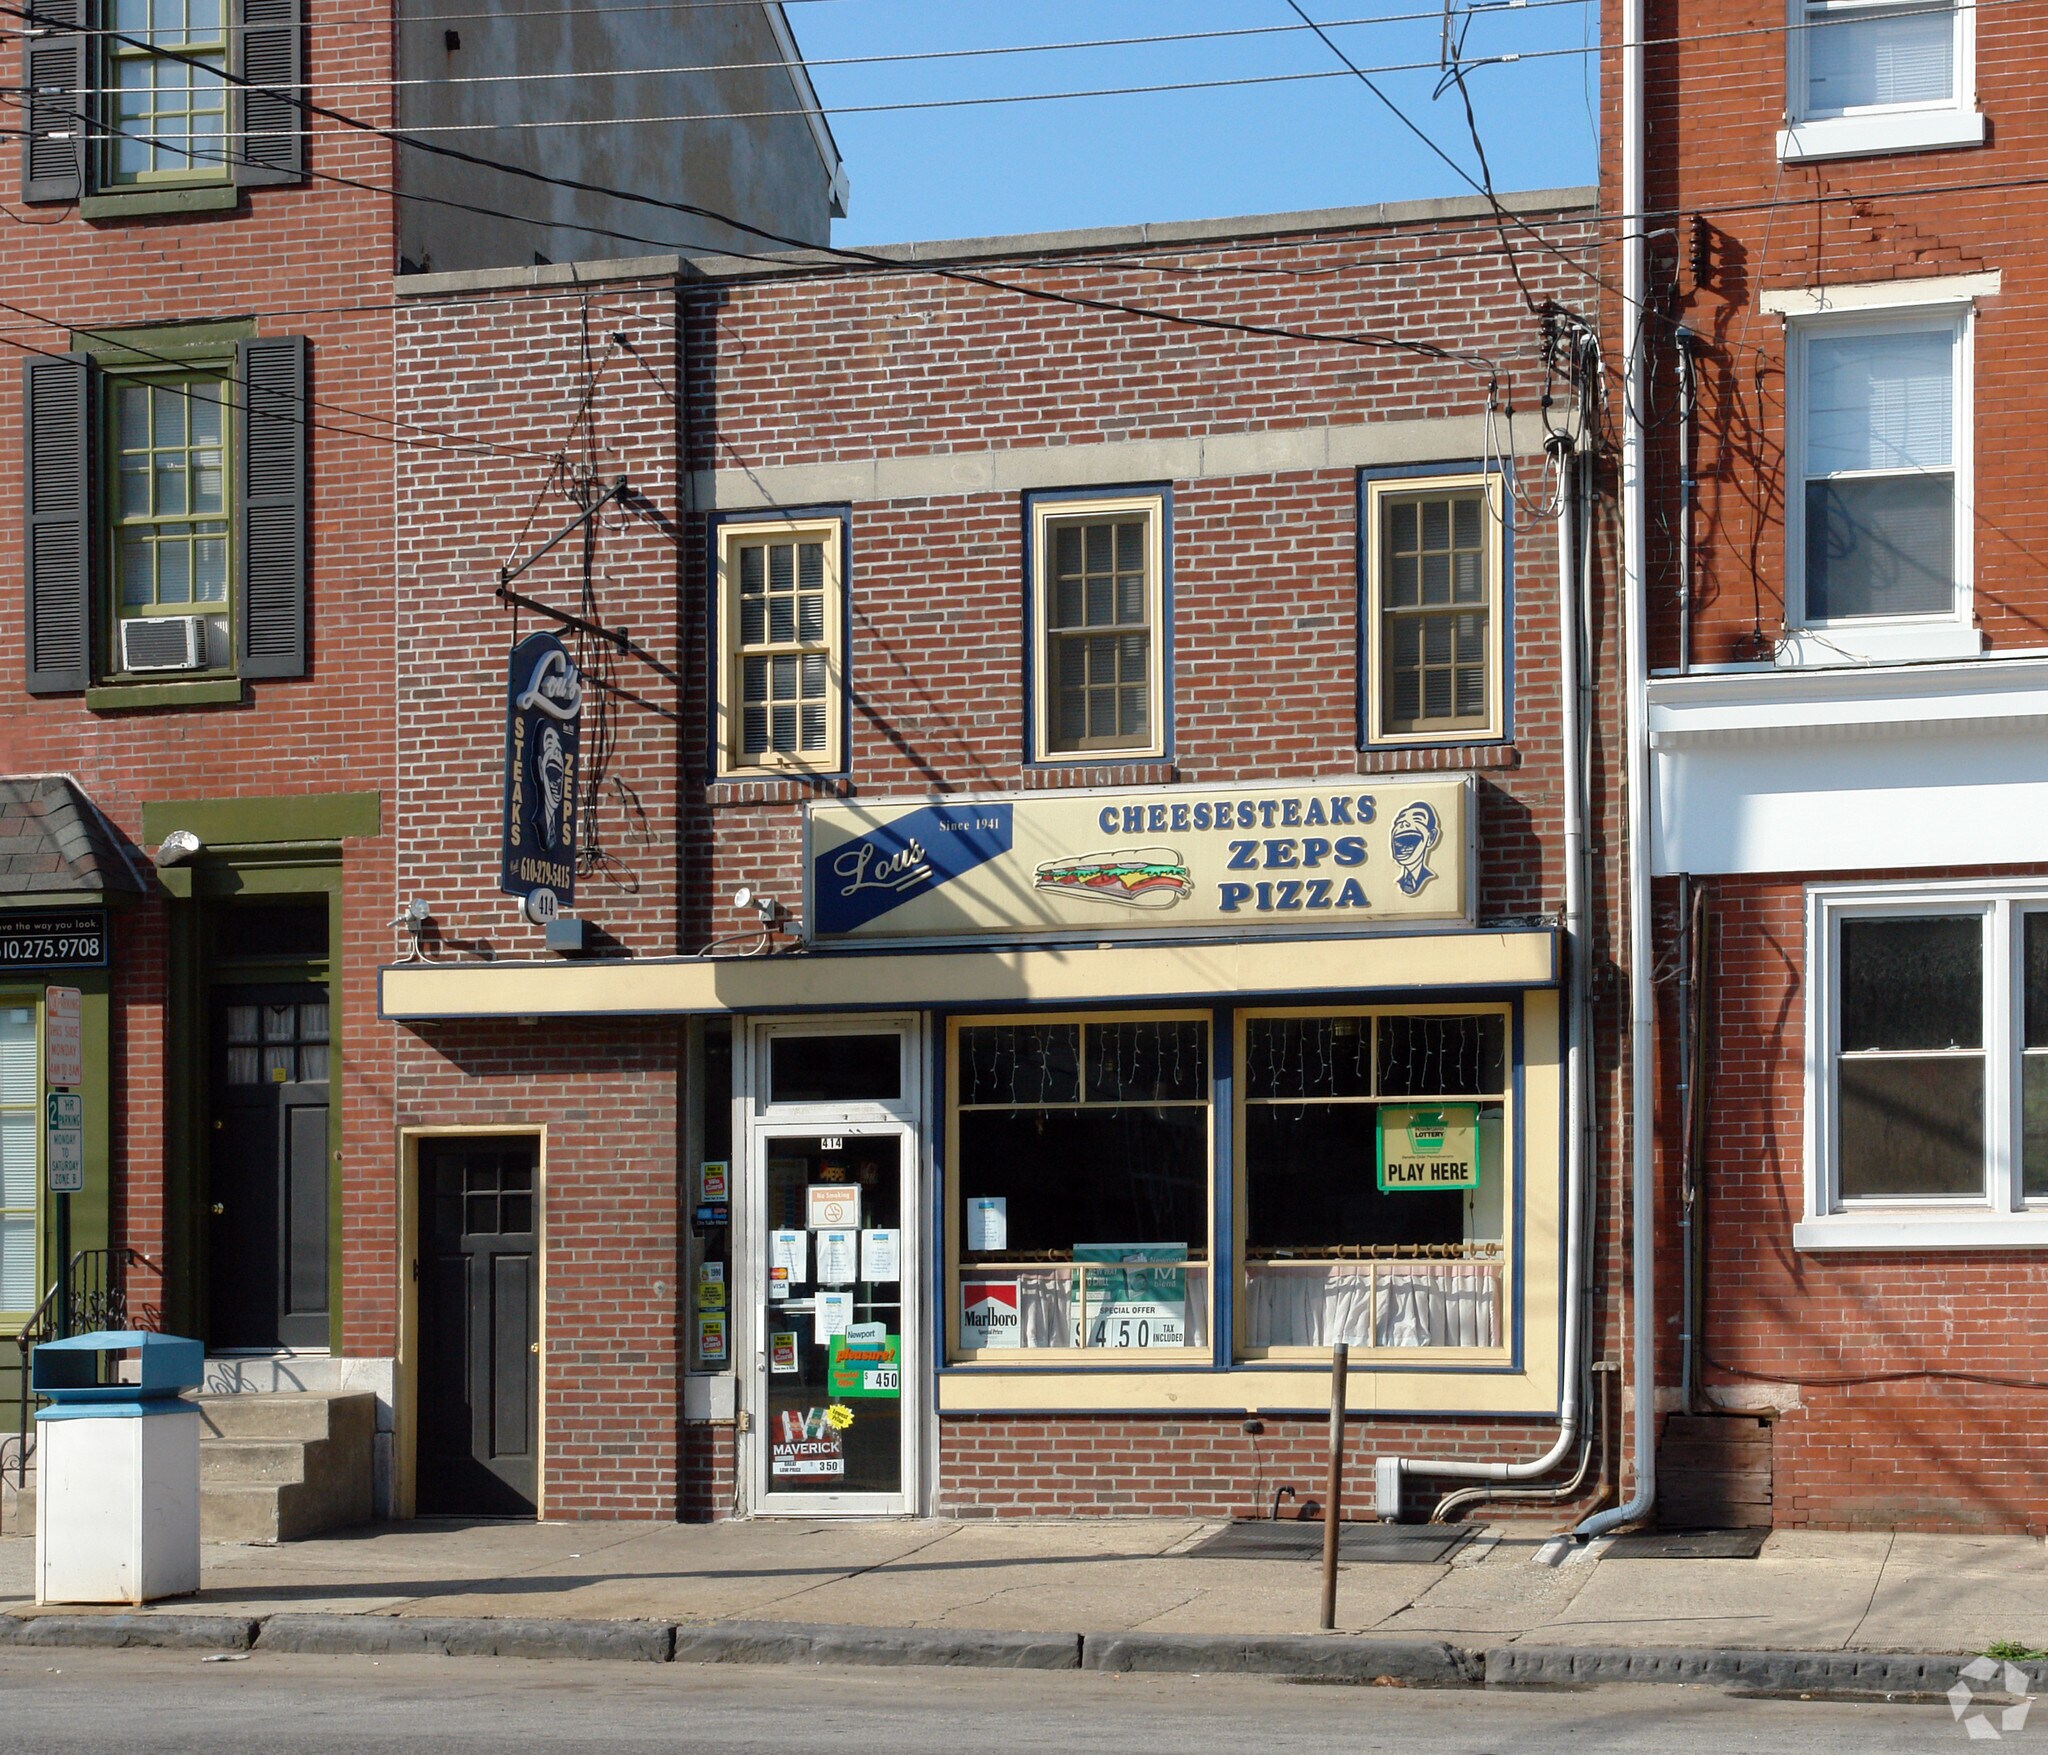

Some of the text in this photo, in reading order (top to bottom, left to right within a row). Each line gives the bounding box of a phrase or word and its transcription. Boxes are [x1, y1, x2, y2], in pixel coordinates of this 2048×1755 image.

[516, 650, 582, 720] Lou's
[510, 716, 525, 847] STEAKS
[562, 753, 574, 847] ZEPS
[1099, 795, 1377, 834] CHEESESTEAKS
[939, 817, 1000, 832] Since 1941
[1227, 836, 1369, 871] ZEPS
[520, 856, 571, 890] 610-279-5415
[834, 837, 933, 897] Lou's
[1218, 877, 1371, 912] PIZZA
[538, 895, 554, 916] 414
[16, 921, 31, 930] the
[34, 922, 53, 931] way
[55, 921, 72, 931] you
[0, 937, 100, 960] 10.275.9708
[50, 1024, 79, 1038] THIS SIDE
[51, 1043, 77, 1057] MONDAY
[49, 1099, 75, 1125] 2 HR
[58, 1114, 80, 1126] PARKING
[53, 1134, 76, 1145] MONDAY
[822, 1137, 842, 1148] 414
[62, 1147, 69, 1159] TO
[52, 1160, 79, 1172] SATURDAY
[1388, 1162, 1469, 1182] PLAY HERE
[55, 1173, 70, 1186] ZONE
[816, 1191, 850, 1200] No Smoking
[1153, 1280, 1177, 1288] blend
[964, 1306, 1018, 1327] Marlboro
[1100, 1306, 1156, 1314] SPECIAL OFFER
[847, 1329, 876, 1341] Newport
[1163, 1324, 1175, 1333] TAX
[1153, 1333, 1183, 1343] INCLUDED
[836, 1348, 895, 1363] pleasure!
[876, 1372, 898, 1388] 450
[773, 1442, 840, 1456] MAVERICK
[819, 1461, 838, 1471] 350
